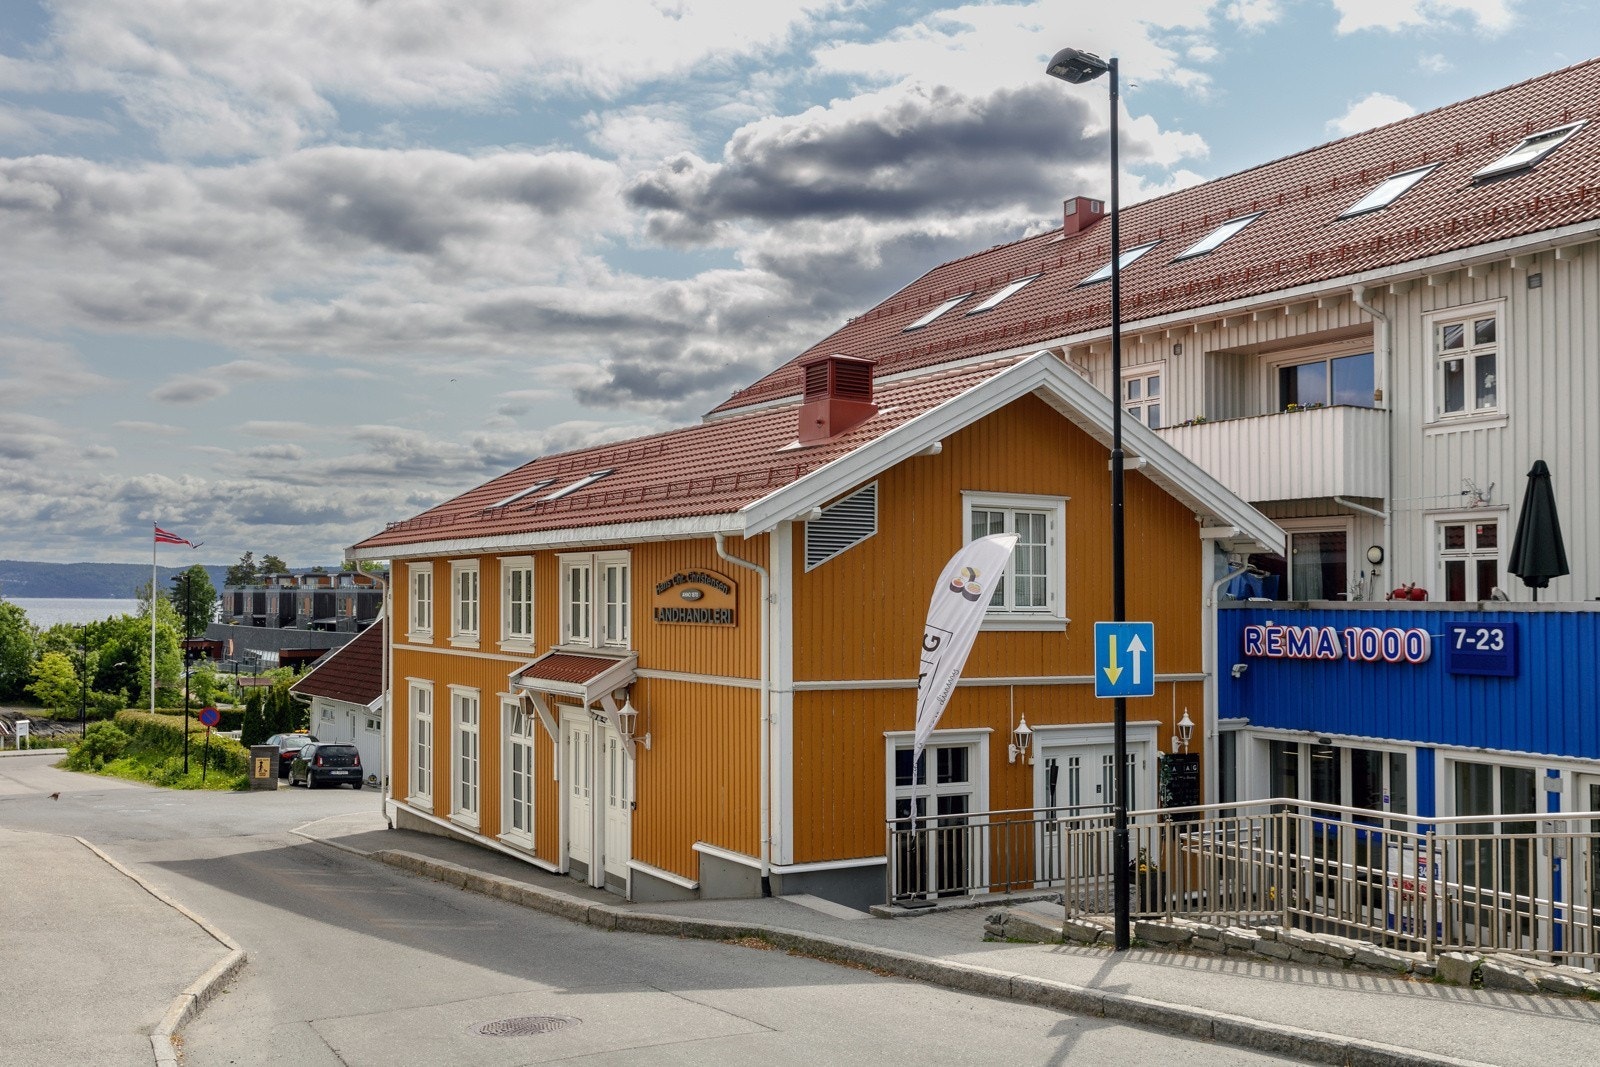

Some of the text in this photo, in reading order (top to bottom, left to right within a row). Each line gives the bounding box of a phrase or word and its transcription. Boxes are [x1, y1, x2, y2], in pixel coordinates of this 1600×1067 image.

[687, 571, 729, 595] Christensen
[654, 607, 733, 624] LANDHANDLERI
[1244, 625, 1431, 664] REMA 1000
[1453, 628, 1505, 651] 7-23
